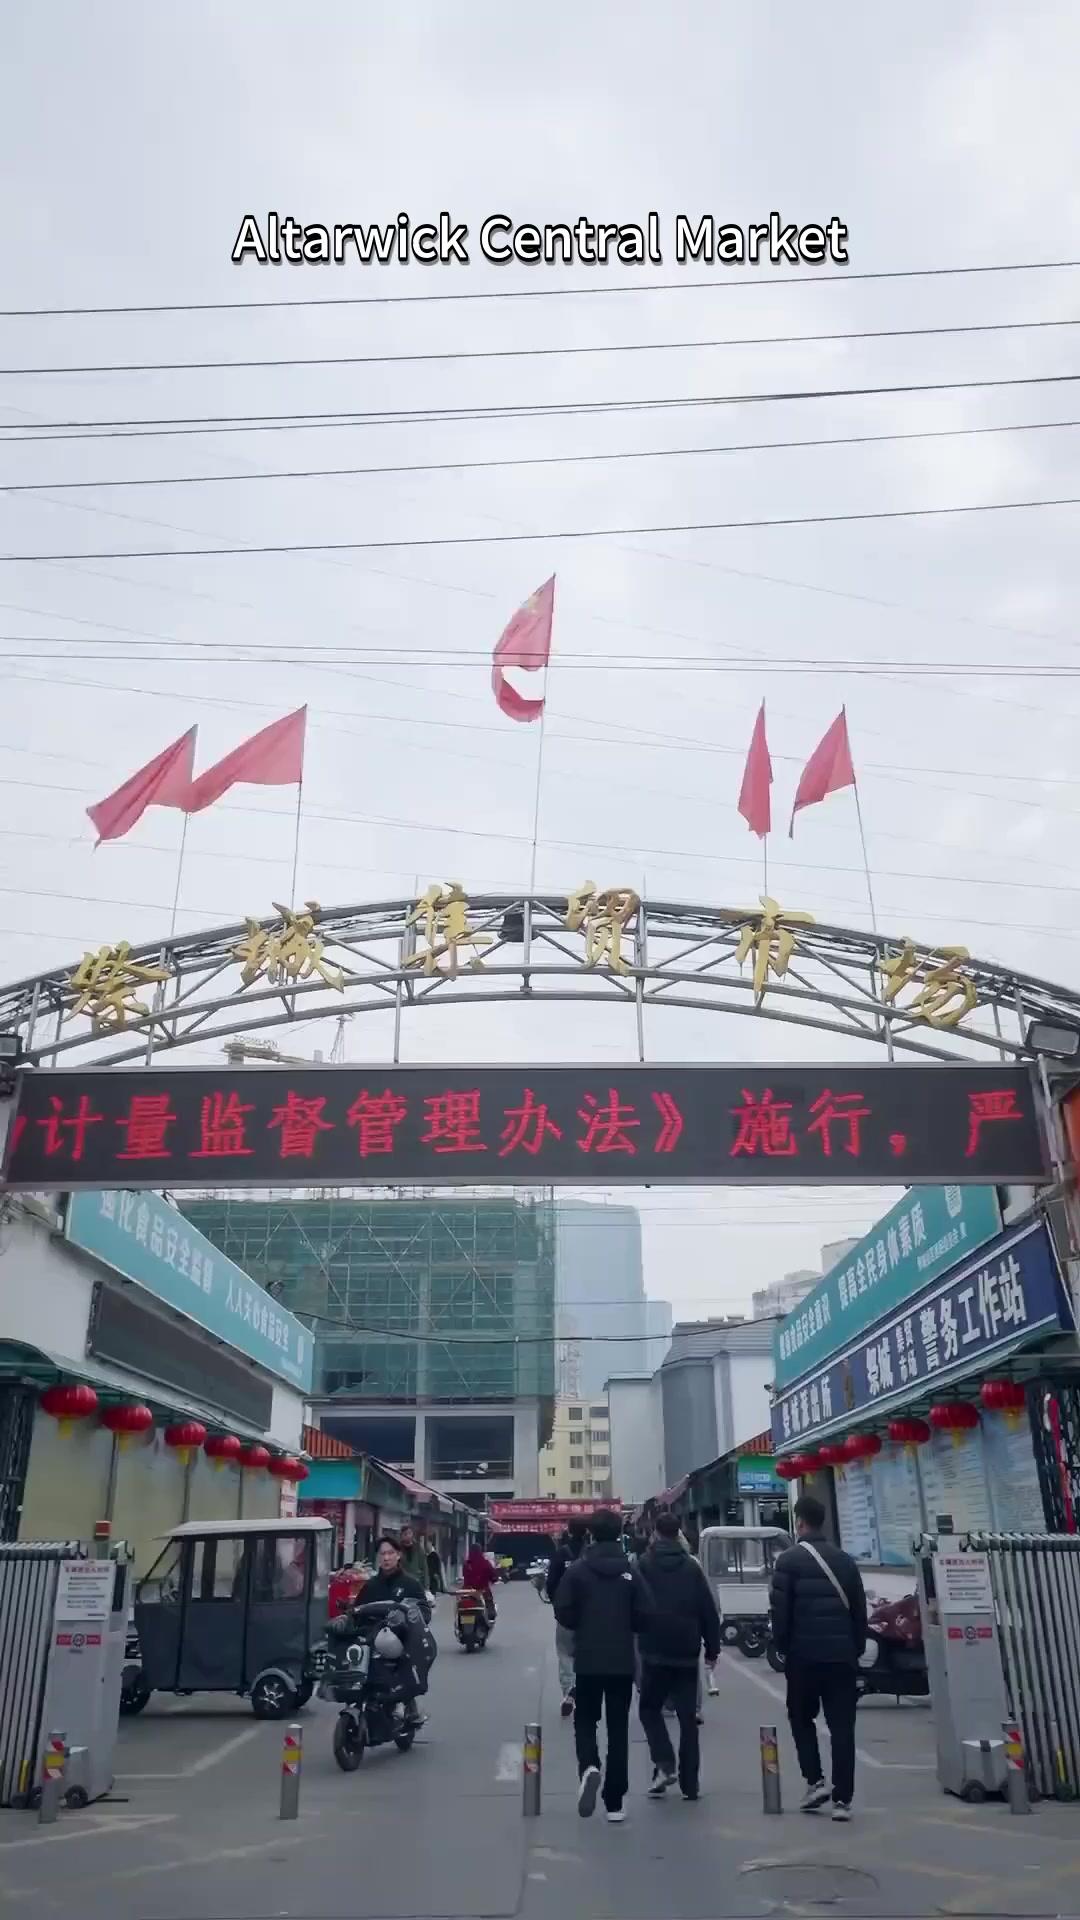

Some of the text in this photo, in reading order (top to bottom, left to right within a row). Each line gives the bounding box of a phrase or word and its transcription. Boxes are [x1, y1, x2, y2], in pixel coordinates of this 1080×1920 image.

[12, 1088, 1023, 1160] 计量监督管理办法》施行，严
[920, 1255, 1027, 1373] 警务工作站
